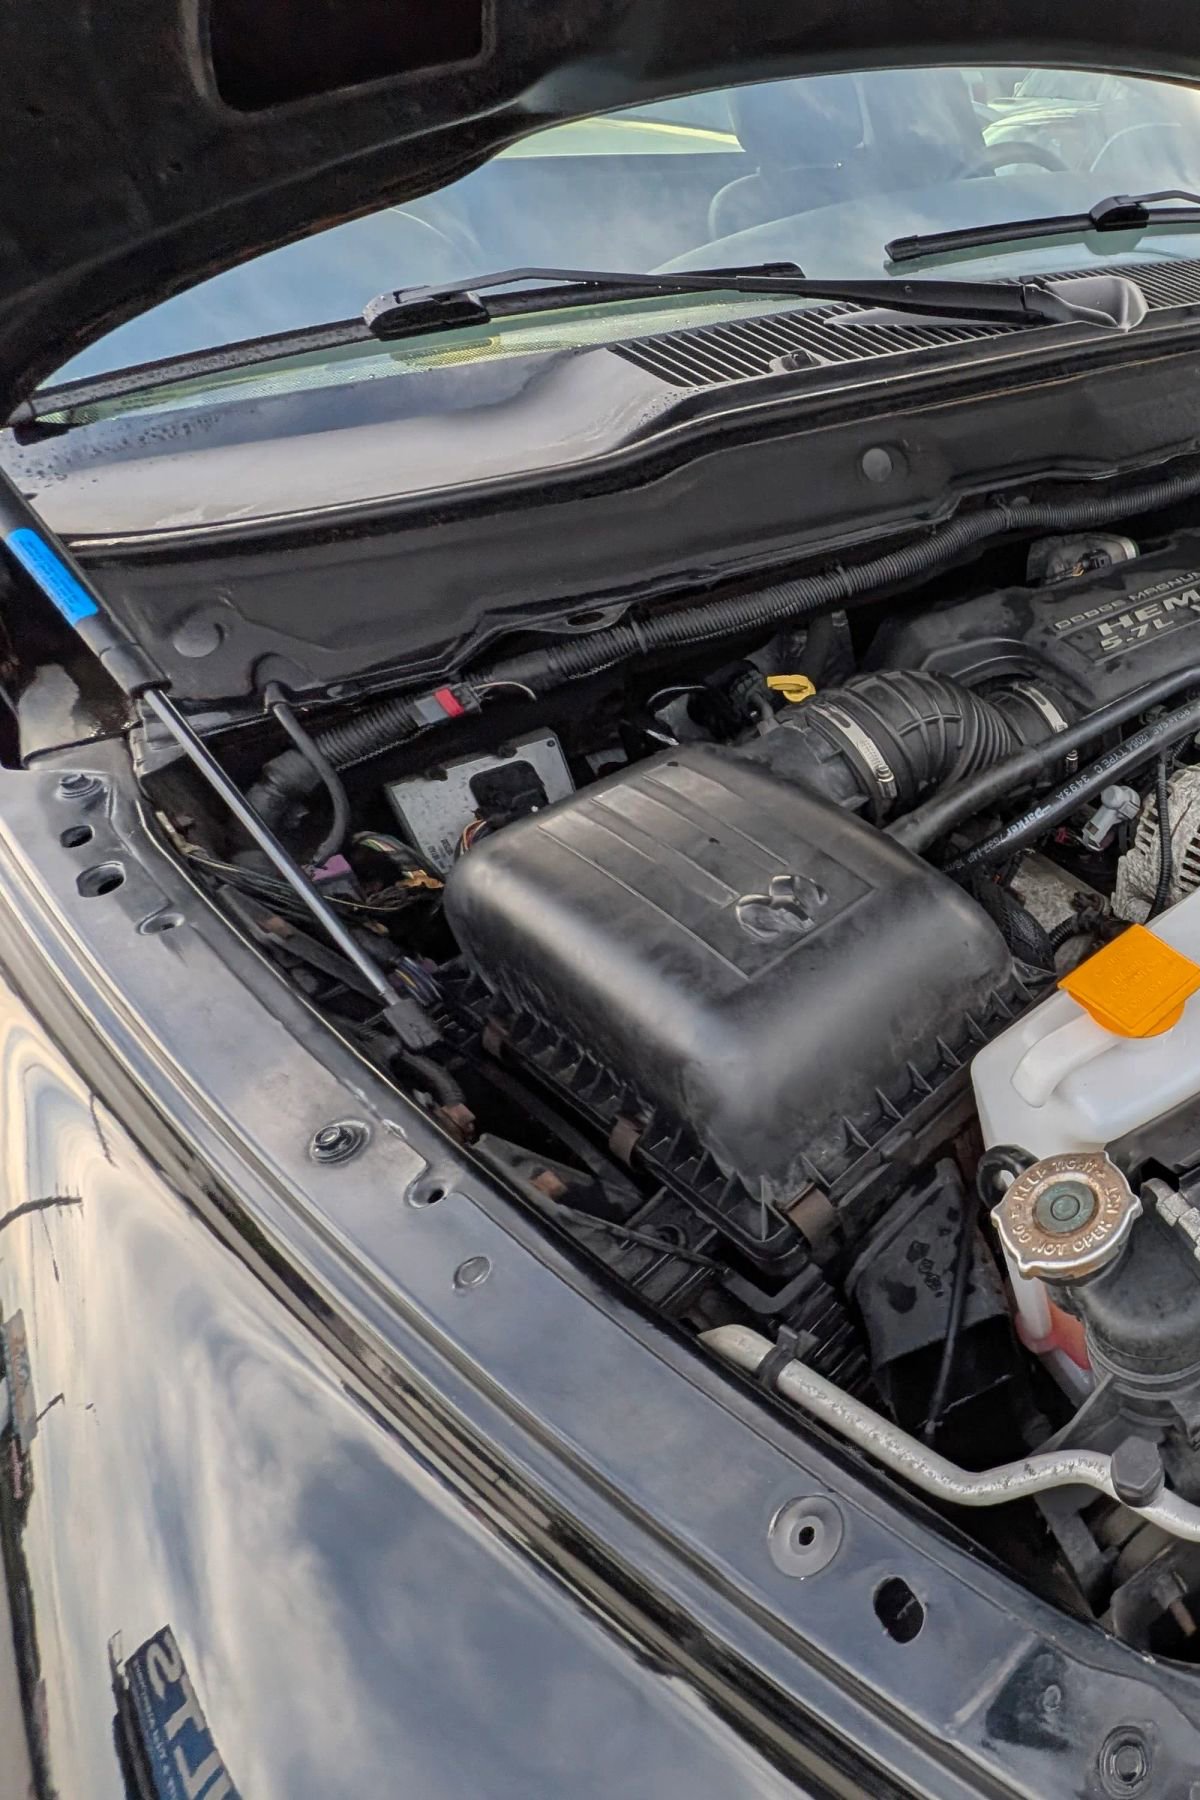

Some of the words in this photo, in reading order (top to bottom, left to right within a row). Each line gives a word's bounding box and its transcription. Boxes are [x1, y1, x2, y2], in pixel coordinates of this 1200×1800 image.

[1054, 600, 1126, 631] DODGE
[1100, 619, 1174, 650] 5.7L
[1093, 766, 1102, 774] C
[1105, 749, 1128, 768] TYPE
[1055, 774, 1090, 801] 3493A
[1006, 804, 1052, 837] Parker
[1032, 1243, 1068, 1256] NOT
